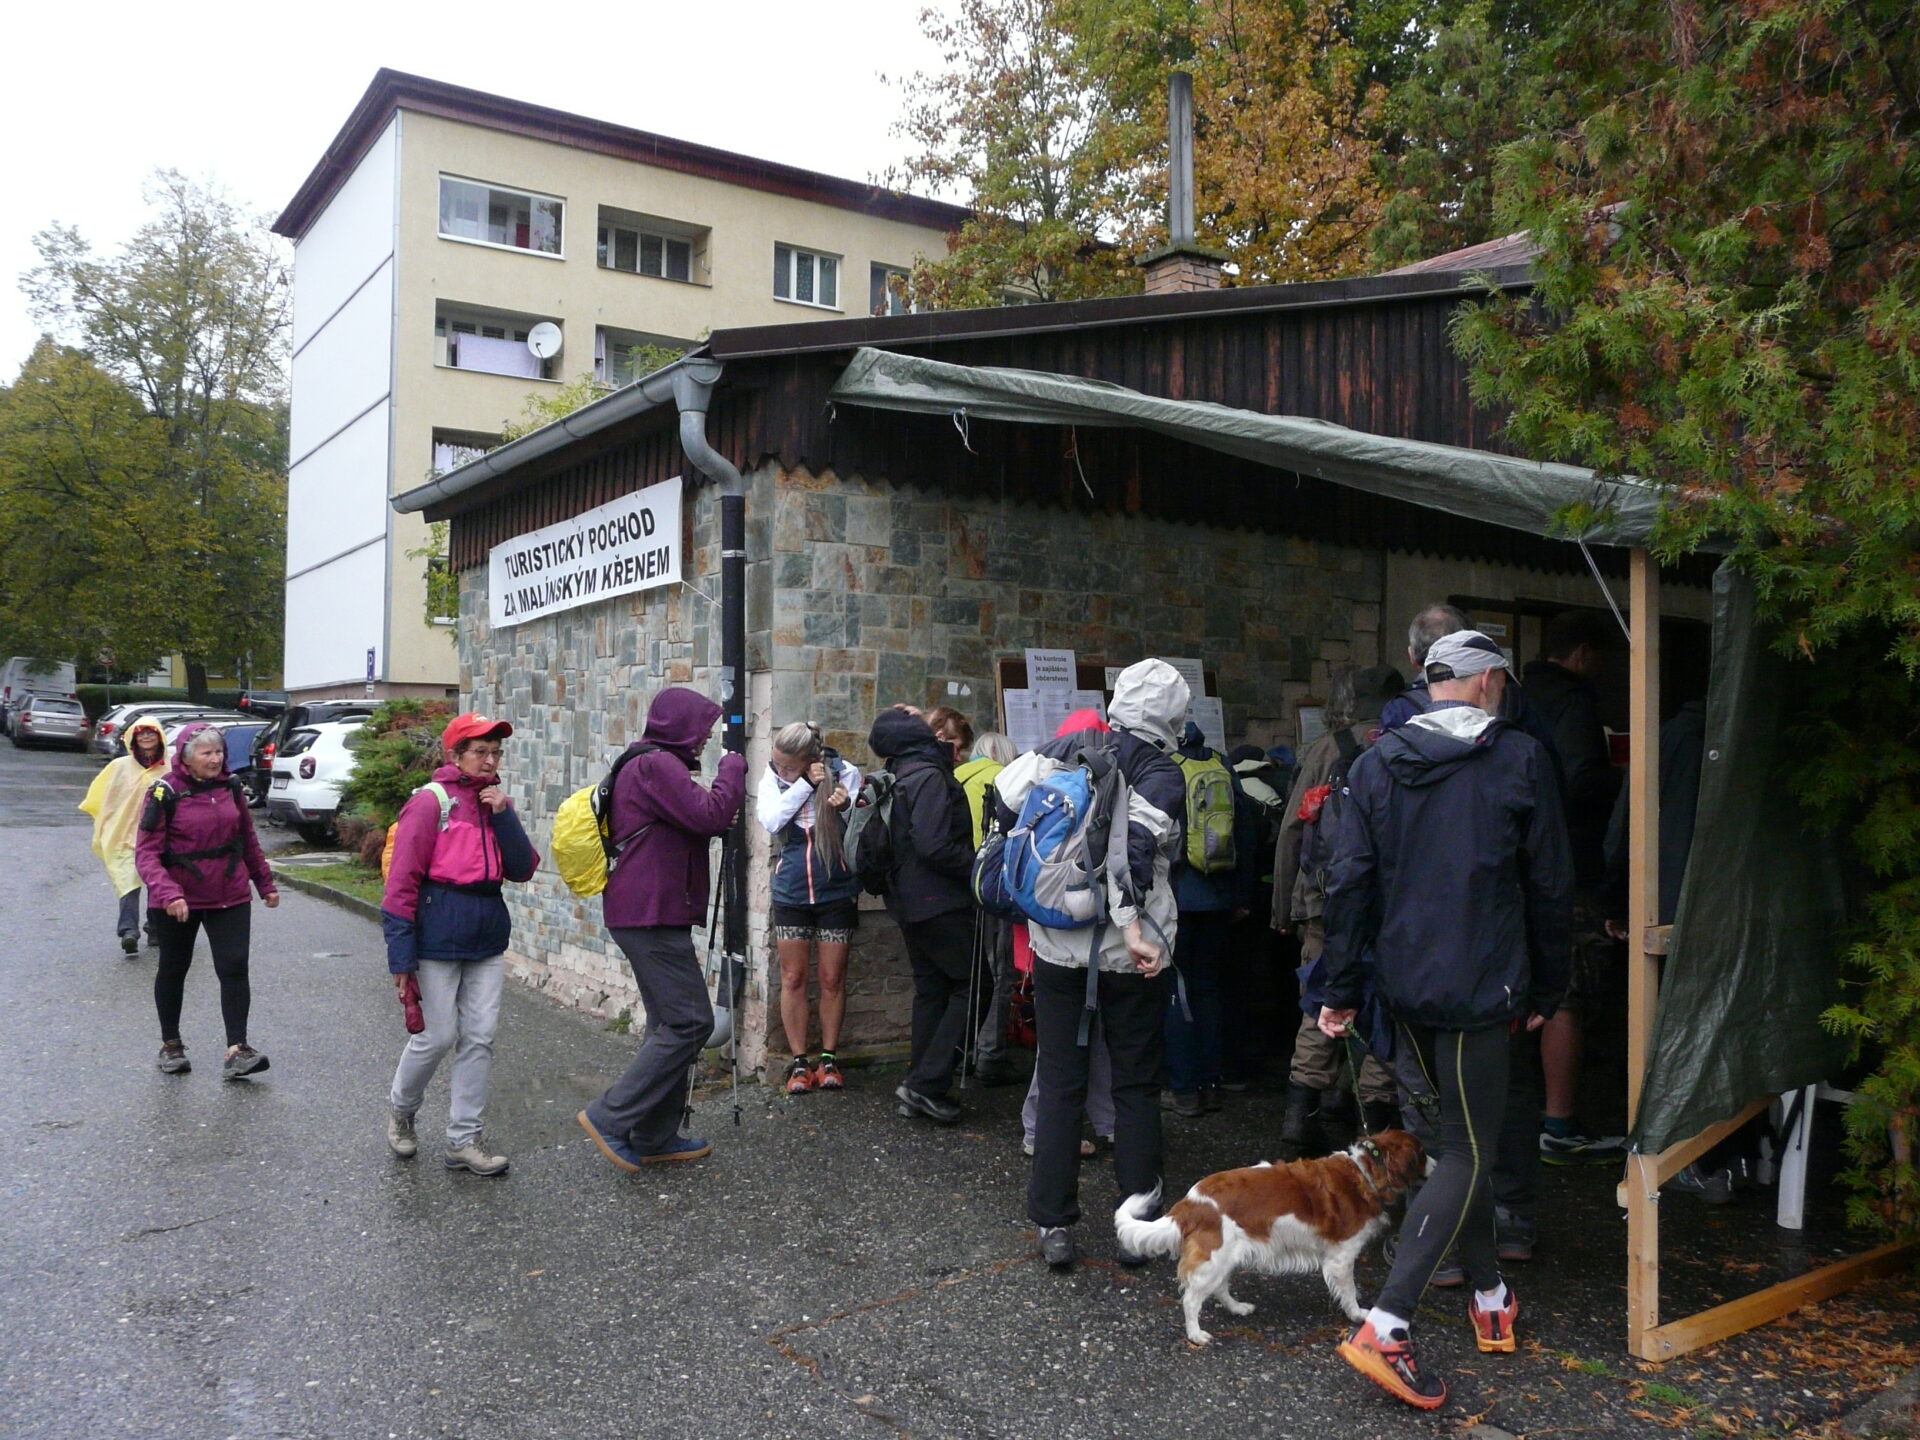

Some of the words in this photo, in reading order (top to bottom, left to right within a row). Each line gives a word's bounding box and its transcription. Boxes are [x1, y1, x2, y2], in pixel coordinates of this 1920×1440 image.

[505, 525, 584, 580] TURISTICKÝ
[589, 507, 655, 554] POCHOD
[504, 595, 516, 616] ZA
[518, 565, 597, 613] MALÍNSKÝM
[601, 545, 670, 592] KŘENEM
